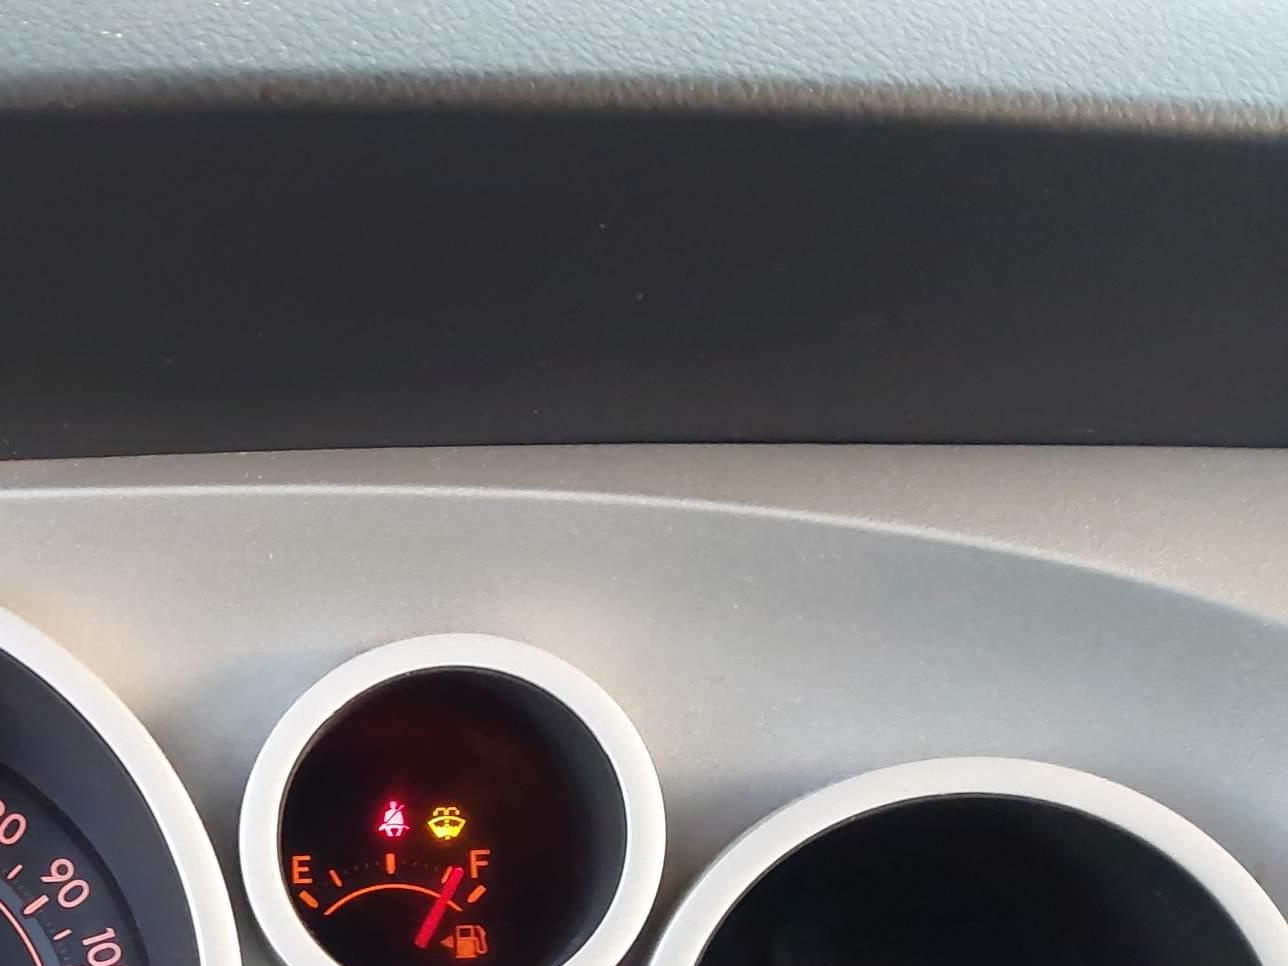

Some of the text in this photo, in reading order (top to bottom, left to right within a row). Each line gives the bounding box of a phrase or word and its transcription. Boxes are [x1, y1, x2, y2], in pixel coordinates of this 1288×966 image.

[292, 855, 313, 884] E
[469, 849, 491, 879] F
[40, 858, 90, 908] 90
